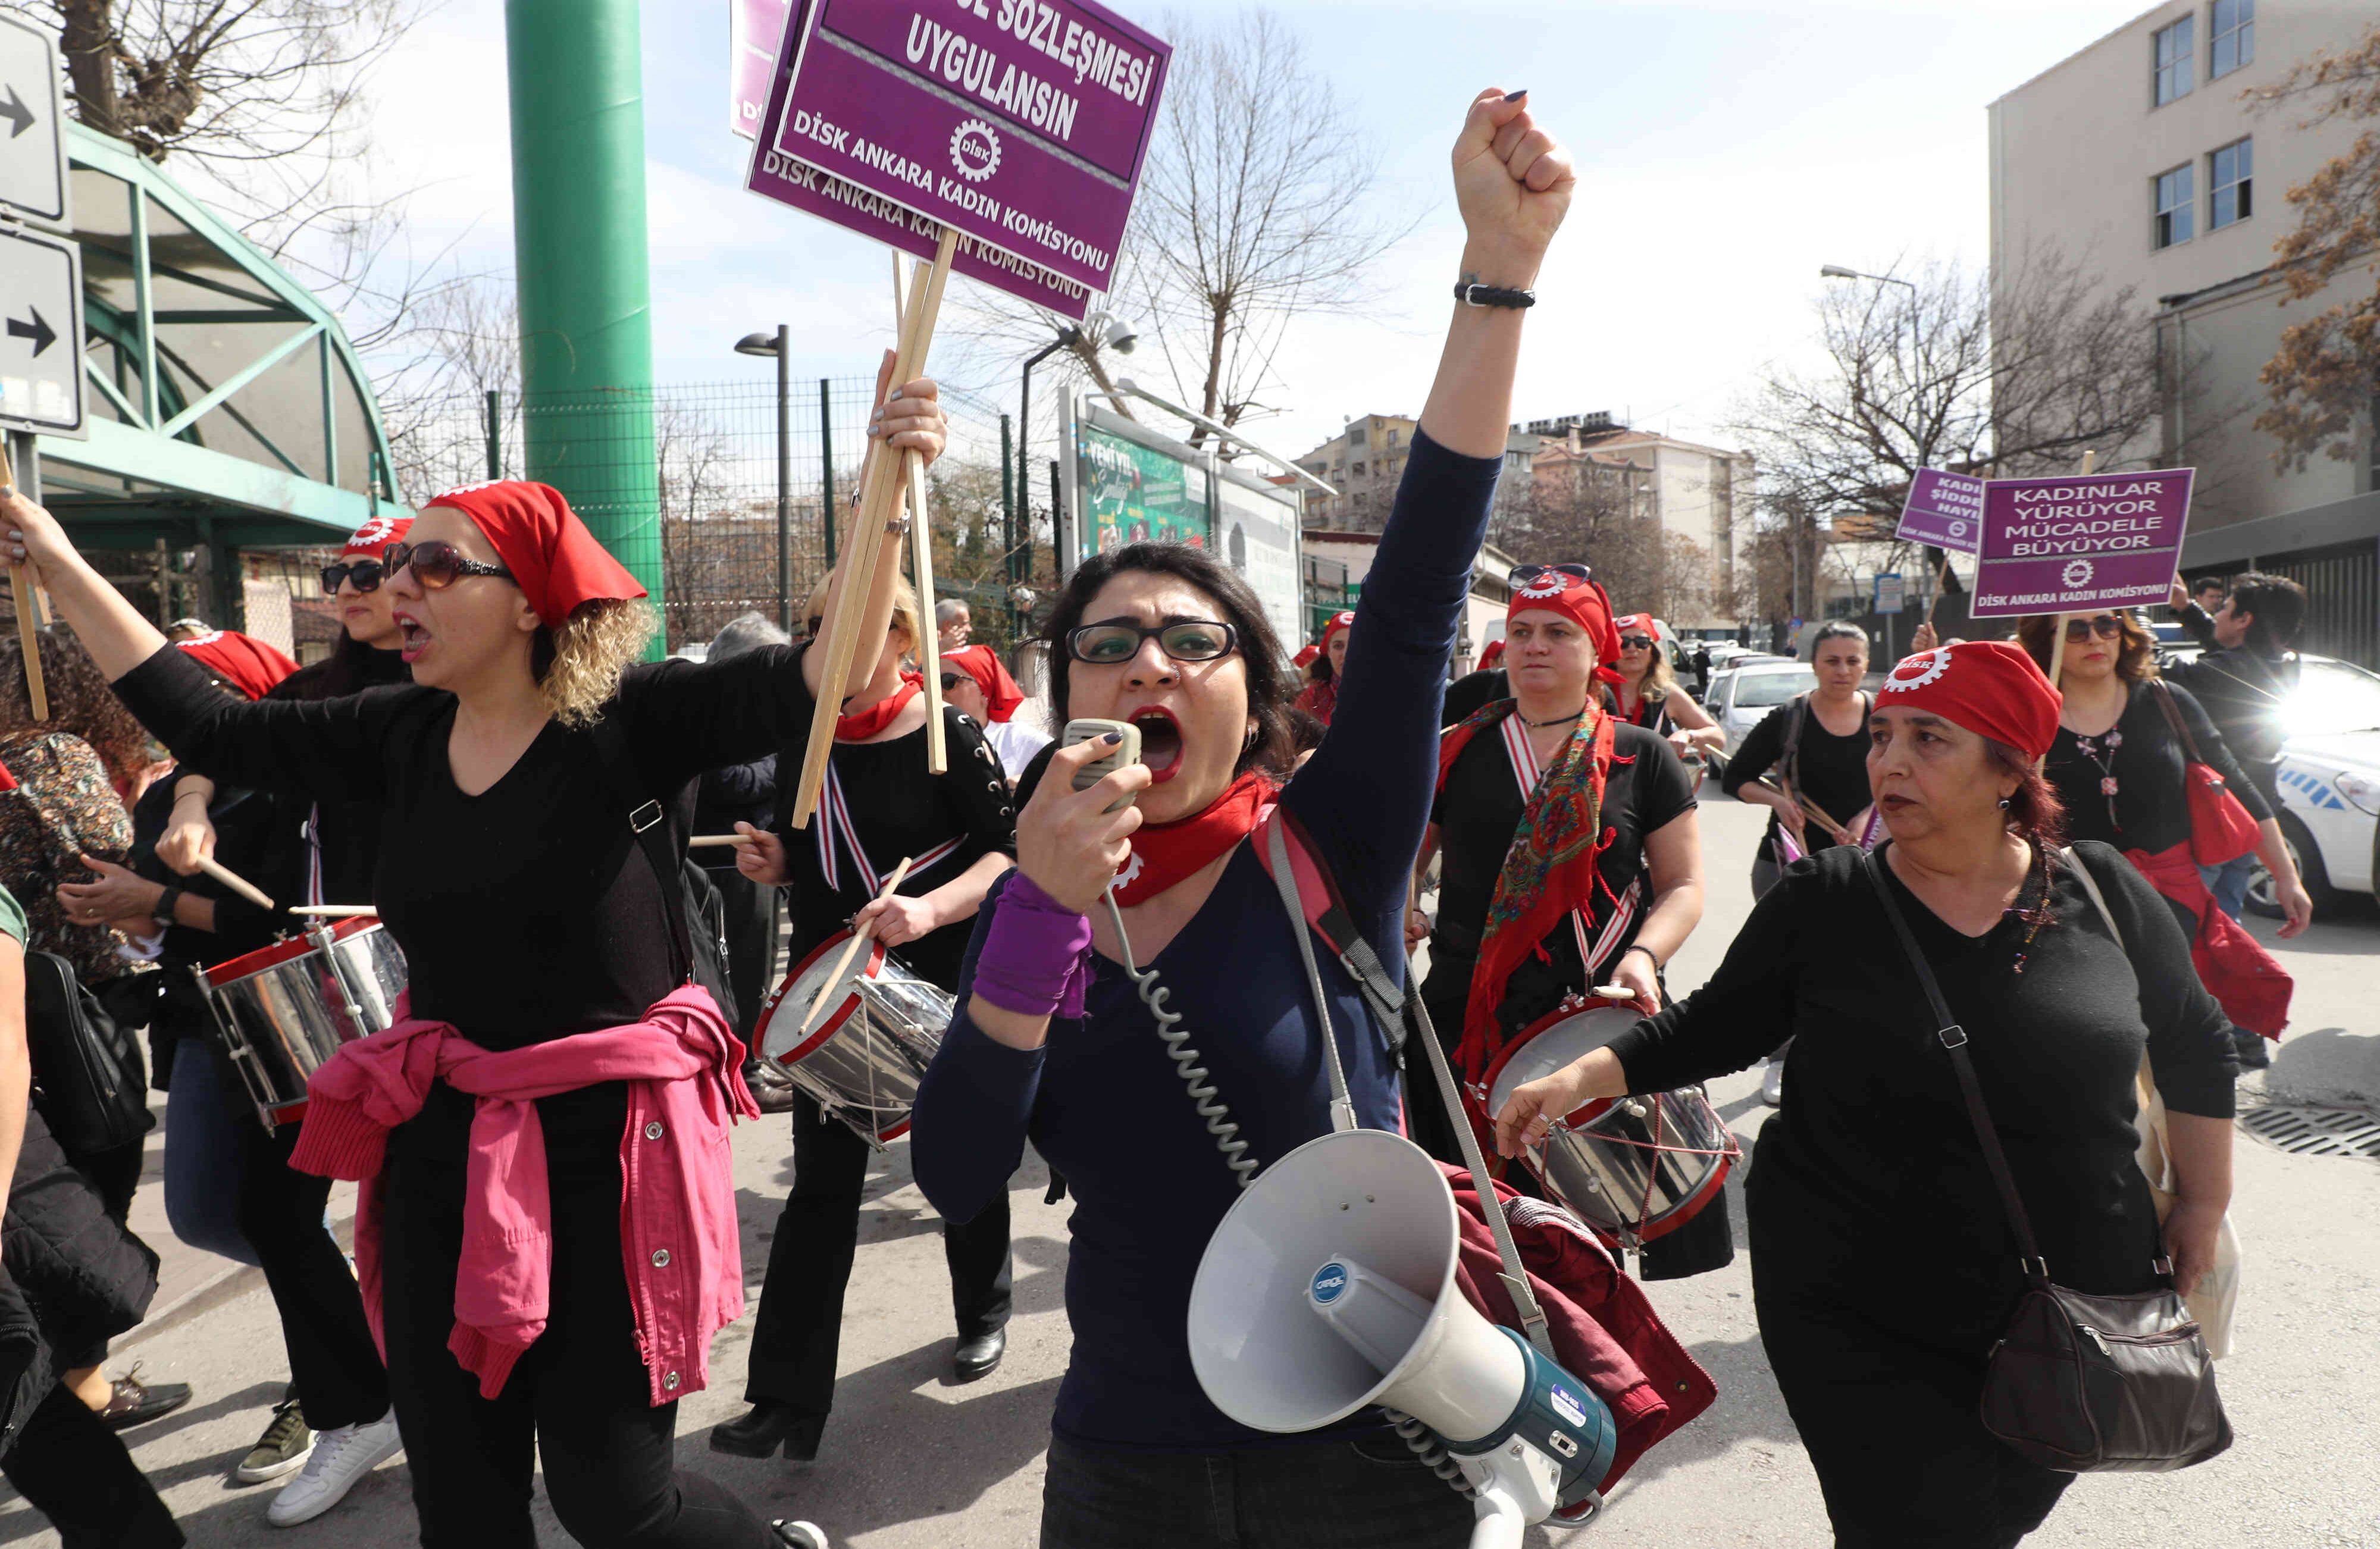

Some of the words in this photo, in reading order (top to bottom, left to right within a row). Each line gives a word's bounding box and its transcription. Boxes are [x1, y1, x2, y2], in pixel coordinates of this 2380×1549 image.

[907, 12, 1079, 142] UYGULANSIN
[794, 109, 850, 153] DİSK
[850, 137, 933, 193] ANKARA
[938, 176, 1001, 222] KADIN
[1002, 206, 1110, 272] KOMİSYONU
[821, 176, 904, 228] ANKARA
[909, 215, 972, 255] KAN
[1937, 477, 1981, 495] KADI
[2013, 482, 2163, 503] KADINLAR
[1937, 502, 1981, 520] HAYI
[2015, 500, 2157, 520] YÜRÜYOR
[2005, 516, 2164, 539] MÜCADELE
[2012, 535, 2151, 556] BÜYÜYOR
[1978, 594, 2008, 607] DİSK
[2009, 592, 2058, 606] ANKARA
[2059, 589, 2097, 603] KADIN
[2099, 584, 2169, 600] KOMİSYONU
